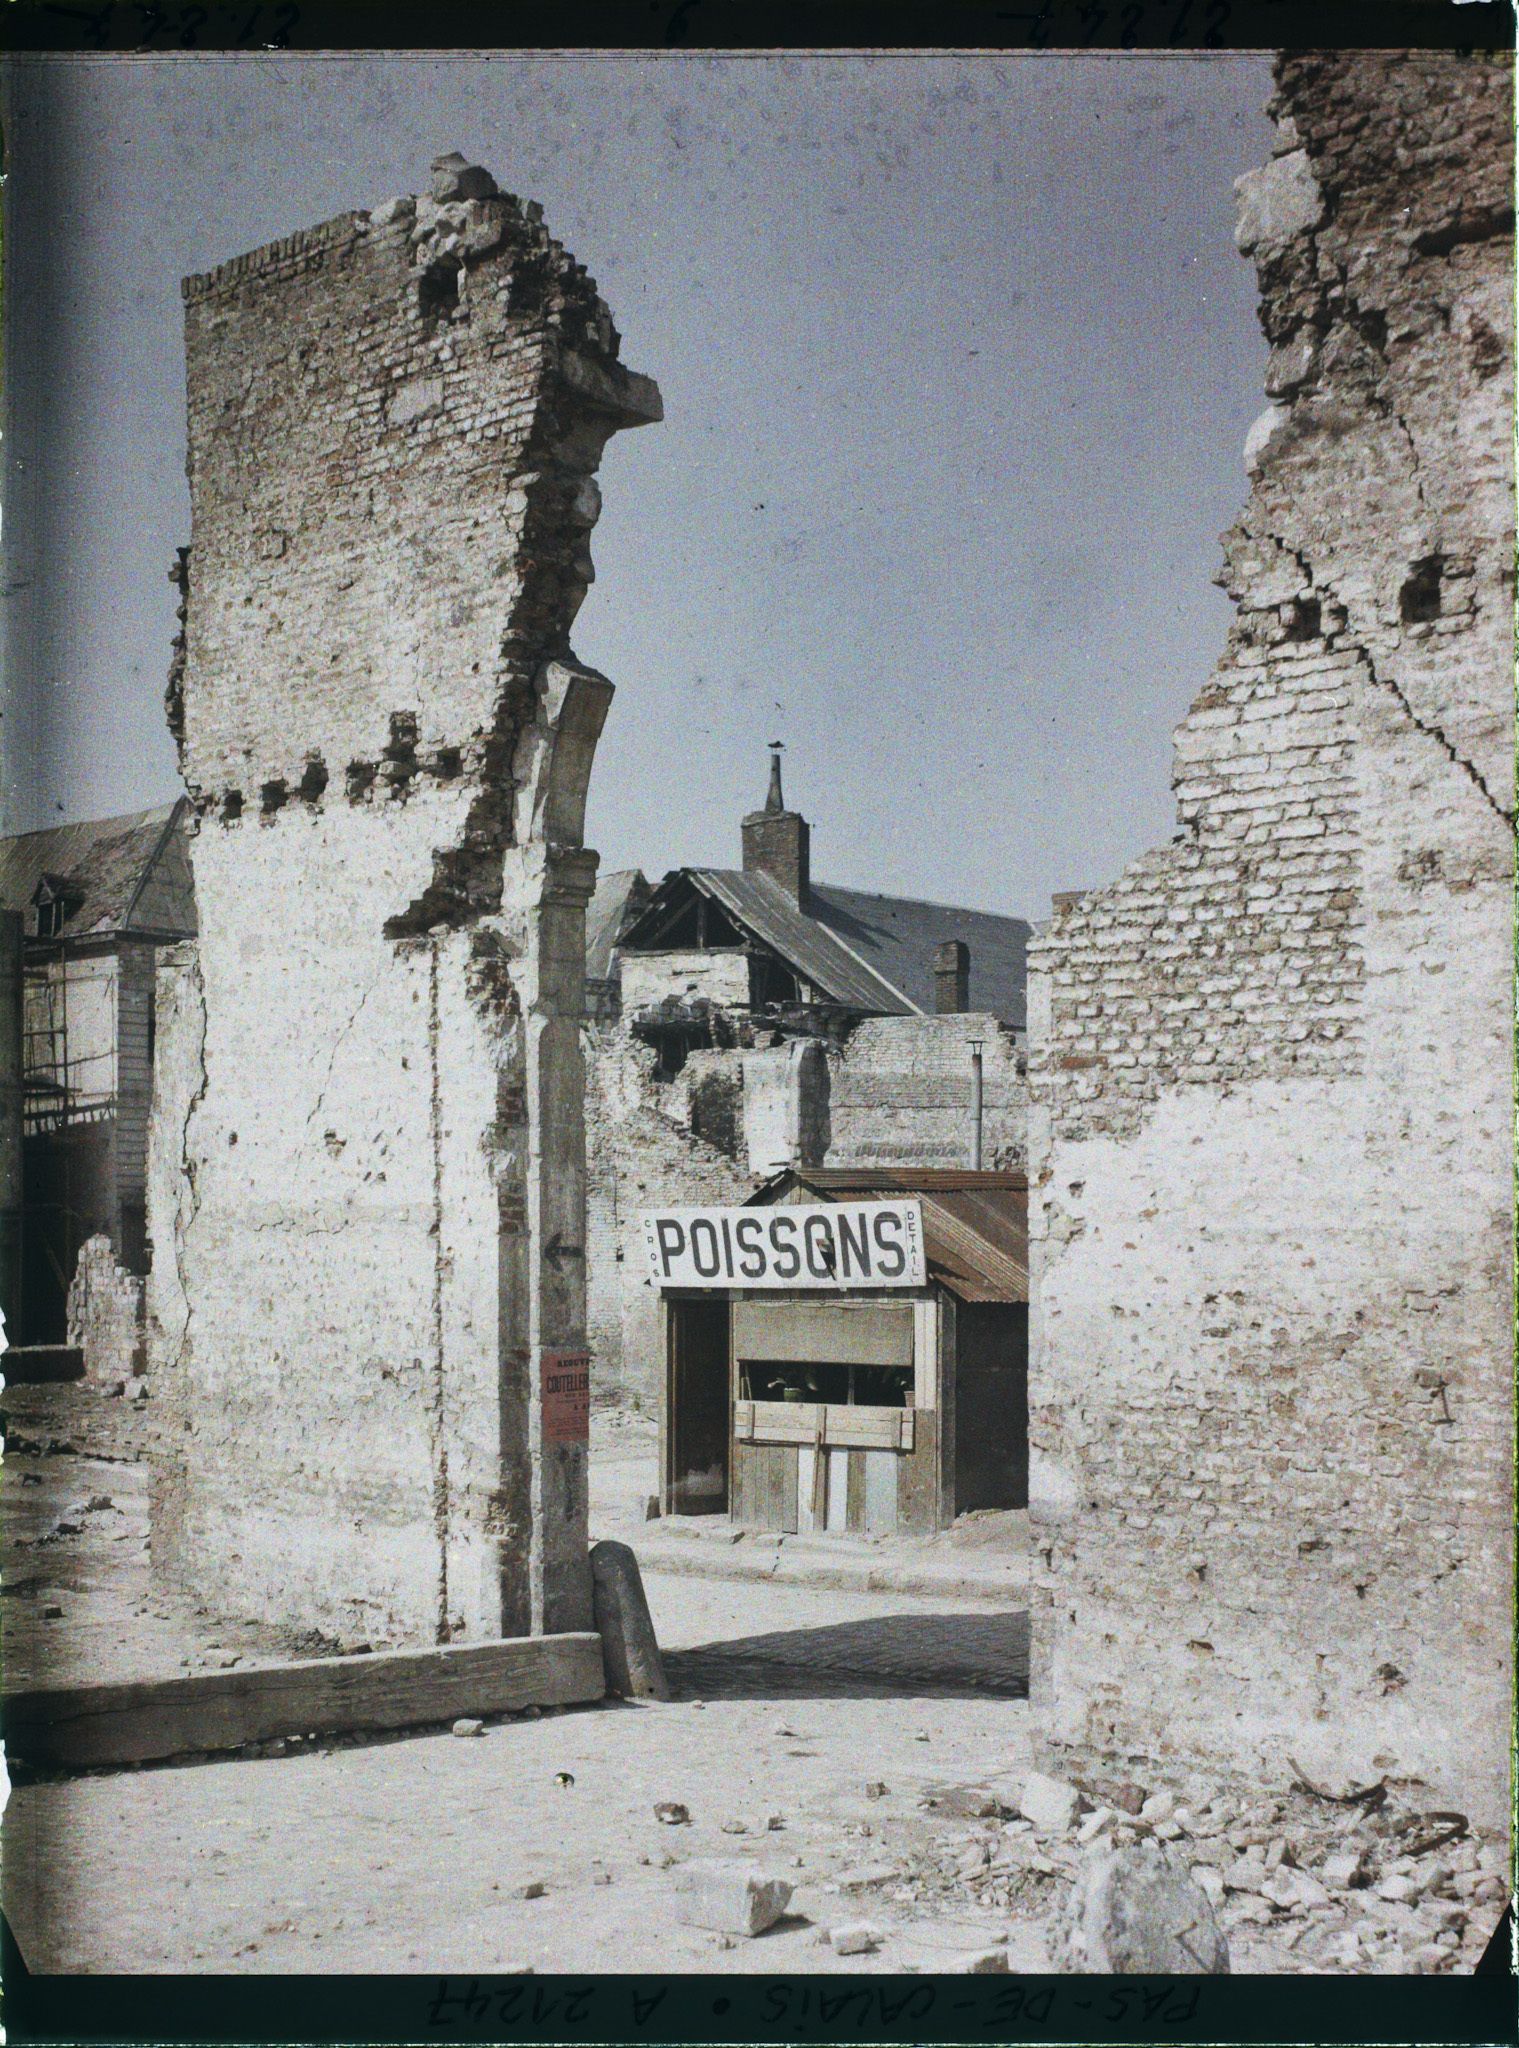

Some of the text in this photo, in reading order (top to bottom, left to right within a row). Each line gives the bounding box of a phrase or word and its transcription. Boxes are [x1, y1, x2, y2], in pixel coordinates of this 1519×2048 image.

[656, 1210, 906, 1279] POISSONS
[906, 1210, 919, 1277] DETAIL
[427, 1978, 596, 2028] 21247
